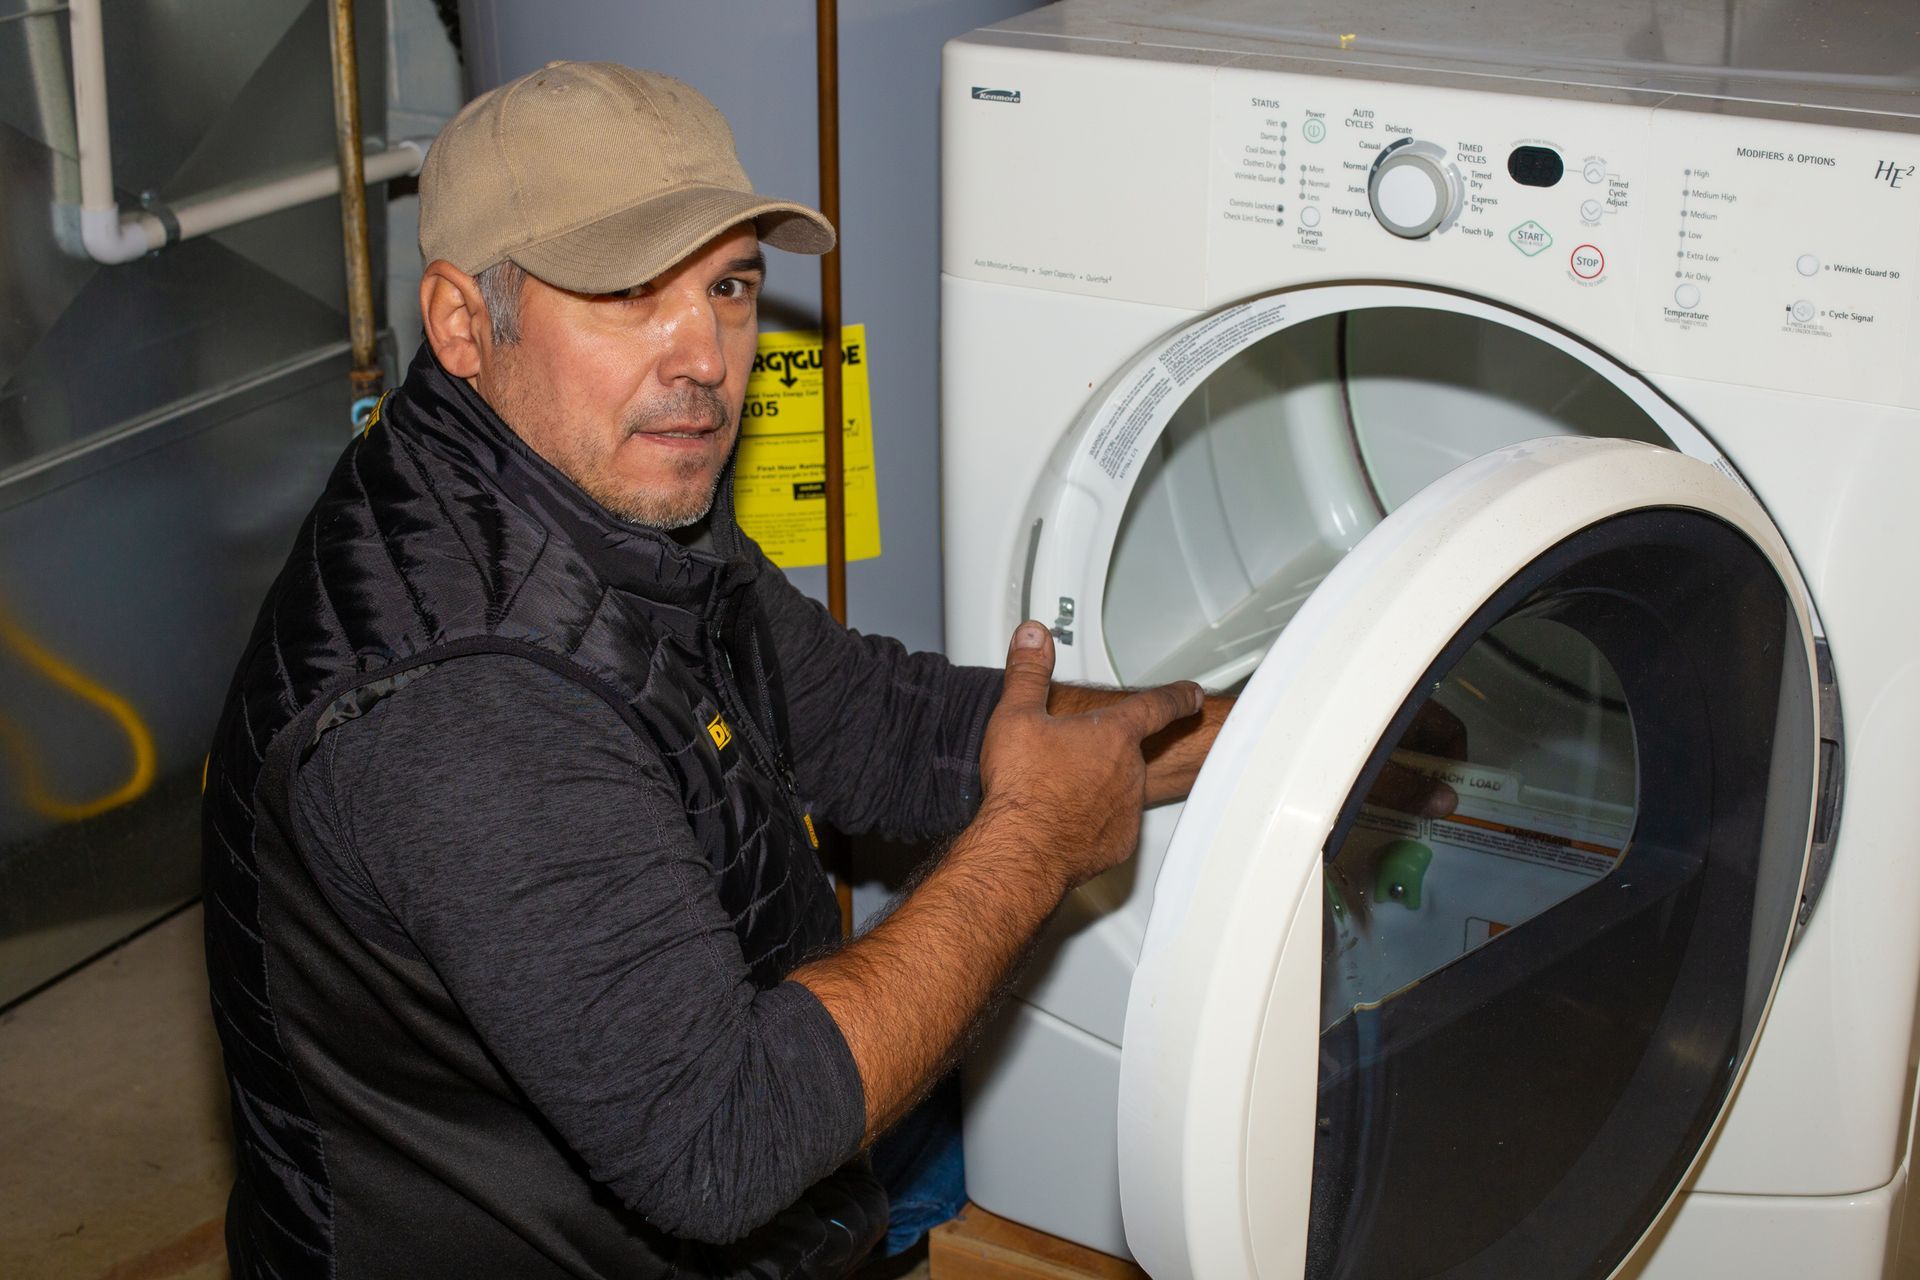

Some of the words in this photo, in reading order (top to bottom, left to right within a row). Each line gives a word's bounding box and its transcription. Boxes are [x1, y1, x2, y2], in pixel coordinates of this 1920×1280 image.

[978, 92, 1021, 103] Kenmore
[1251, 97, 1280, 109] STATUS
[1305, 109, 1326, 118] Power
[1353, 108, 1375, 119] AUTO
[1266, 119, 1278, 127] Wet
[1345, 119, 1374, 129] CYCLES
[1385, 124, 1413, 135] Delicate
[1359, 141, 1381, 150] Casual
[1458, 142, 1483, 153] TIMED
[1456, 153, 1487, 164] CYCLES
[1736, 147, 1785, 162] MODIFIERS
[1787, 154, 1795, 163] &
[1797, 153, 1836, 167] OPTIONS
[1309, 165, 1324, 173] More
[1343, 161, 1368, 171] Normal
[1471, 170, 1492, 180] Timed
[1694, 169, 1710, 179] High
[1308, 180, 1330, 189] Normal
[1347, 185, 1366, 194] Jeans
[1470, 180, 1483, 190] Dry
[1609, 179, 1629, 189] Timed
[1608, 189, 1627, 198] Cycle
[1692, 189, 1719, 200] Medium
[1721, 193, 1737, 203] High
[1472, 195, 1498, 206] Express
[1606, 198, 1628, 208] Adjust
[1332, 206, 1353, 217] Heavy
[1354, 208, 1371, 218] Duty
[1471, 204, 1484, 214] Dry
[1690, 210, 1718, 221] Medium
[1297, 227, 1323, 238] Dryness
[1461, 226, 1481, 236] Touch
[1483, 229, 1494, 238] Up
[1517, 230, 1545, 241] START
[1688, 231, 1702, 240] Low
[1301, 237, 1319, 246] Level
[1576, 256, 1599, 267] STOP
[1686, 251, 1704, 261] Extra
[1705, 254, 1719, 263] Low
[1685, 271, 1696, 280] Air
[1697, 273, 1712, 284] Only
[1834, 264, 1863, 276] Wrinkle
[1865, 267, 1888, 279] Guard
[1889, 270, 1900, 280] 90
[1664, 307, 1710, 321] Temperature
[1829, 310, 1849, 321] Cycle
[1851, 312, 1874, 324] Signal
[1469, 776, 1501, 792] LOAD
